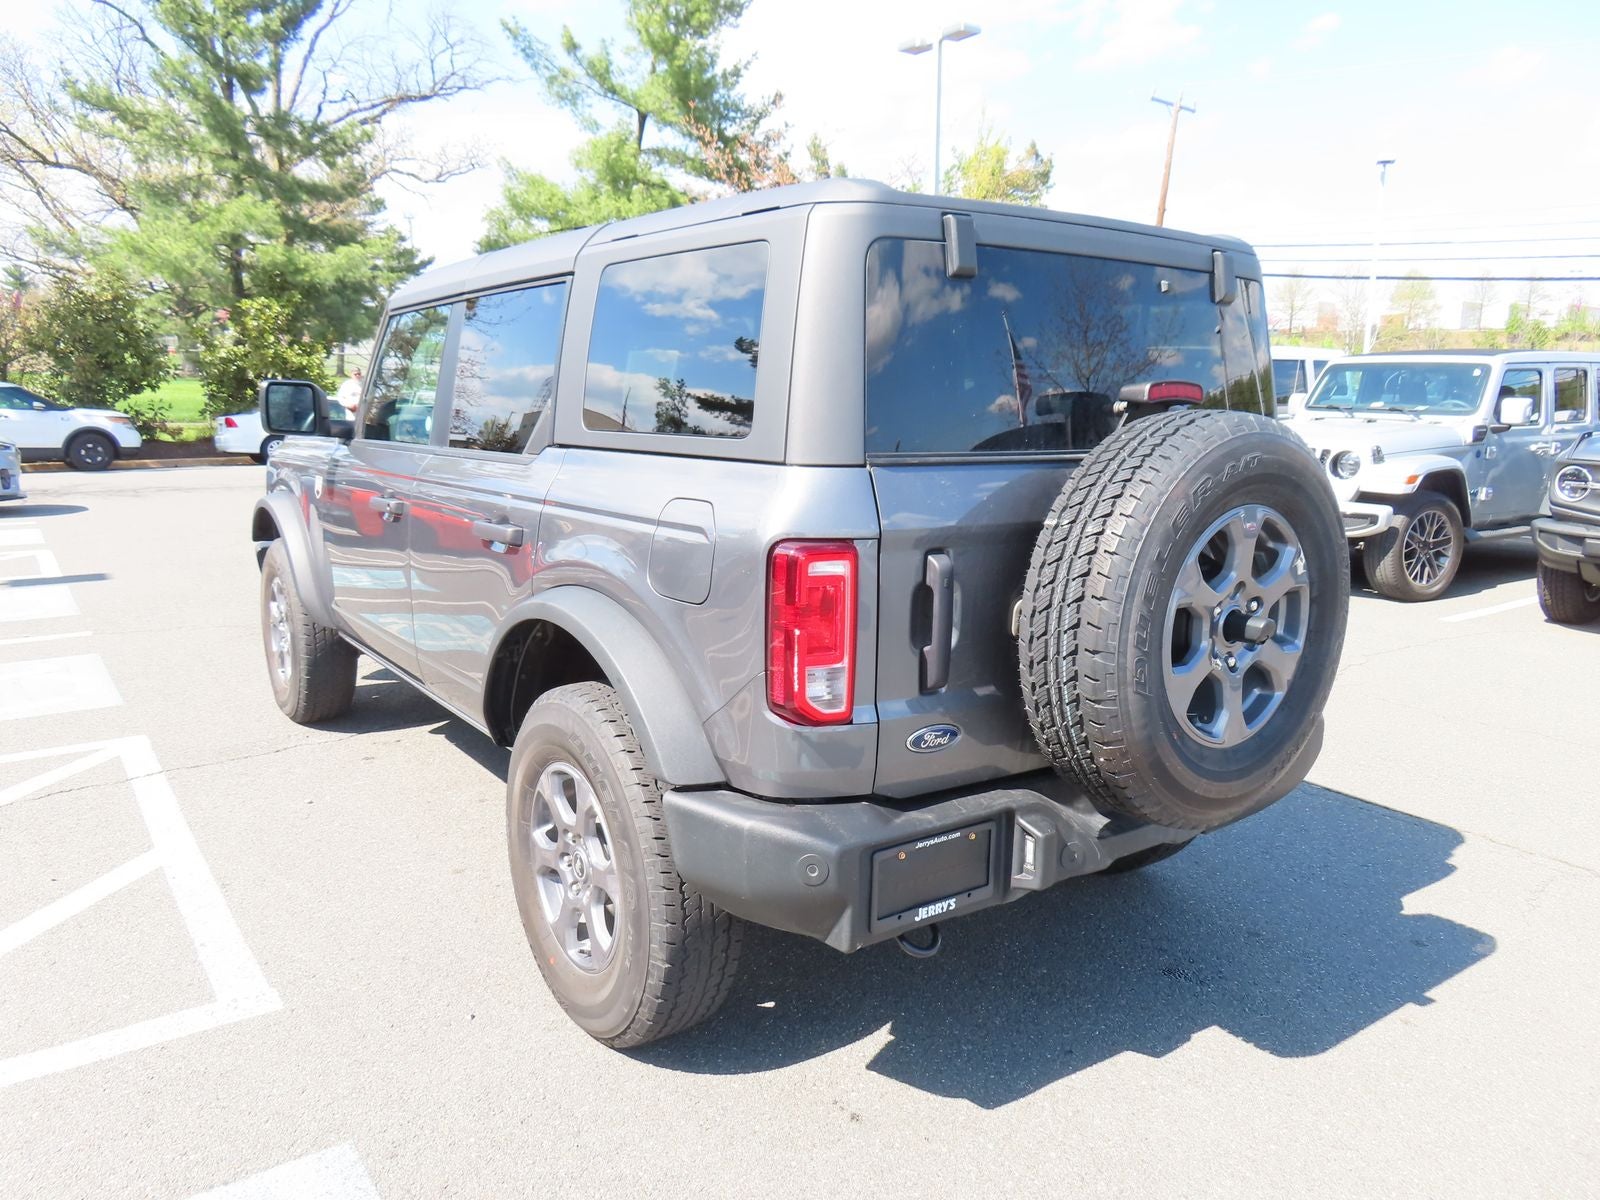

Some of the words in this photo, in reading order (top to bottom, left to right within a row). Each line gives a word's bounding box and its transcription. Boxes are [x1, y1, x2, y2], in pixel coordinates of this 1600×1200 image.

[920, 730, 951, 748] Ford
[915, 832, 961, 849] JerrysAuto.com
[914, 898, 957, 922] JERRY'S
